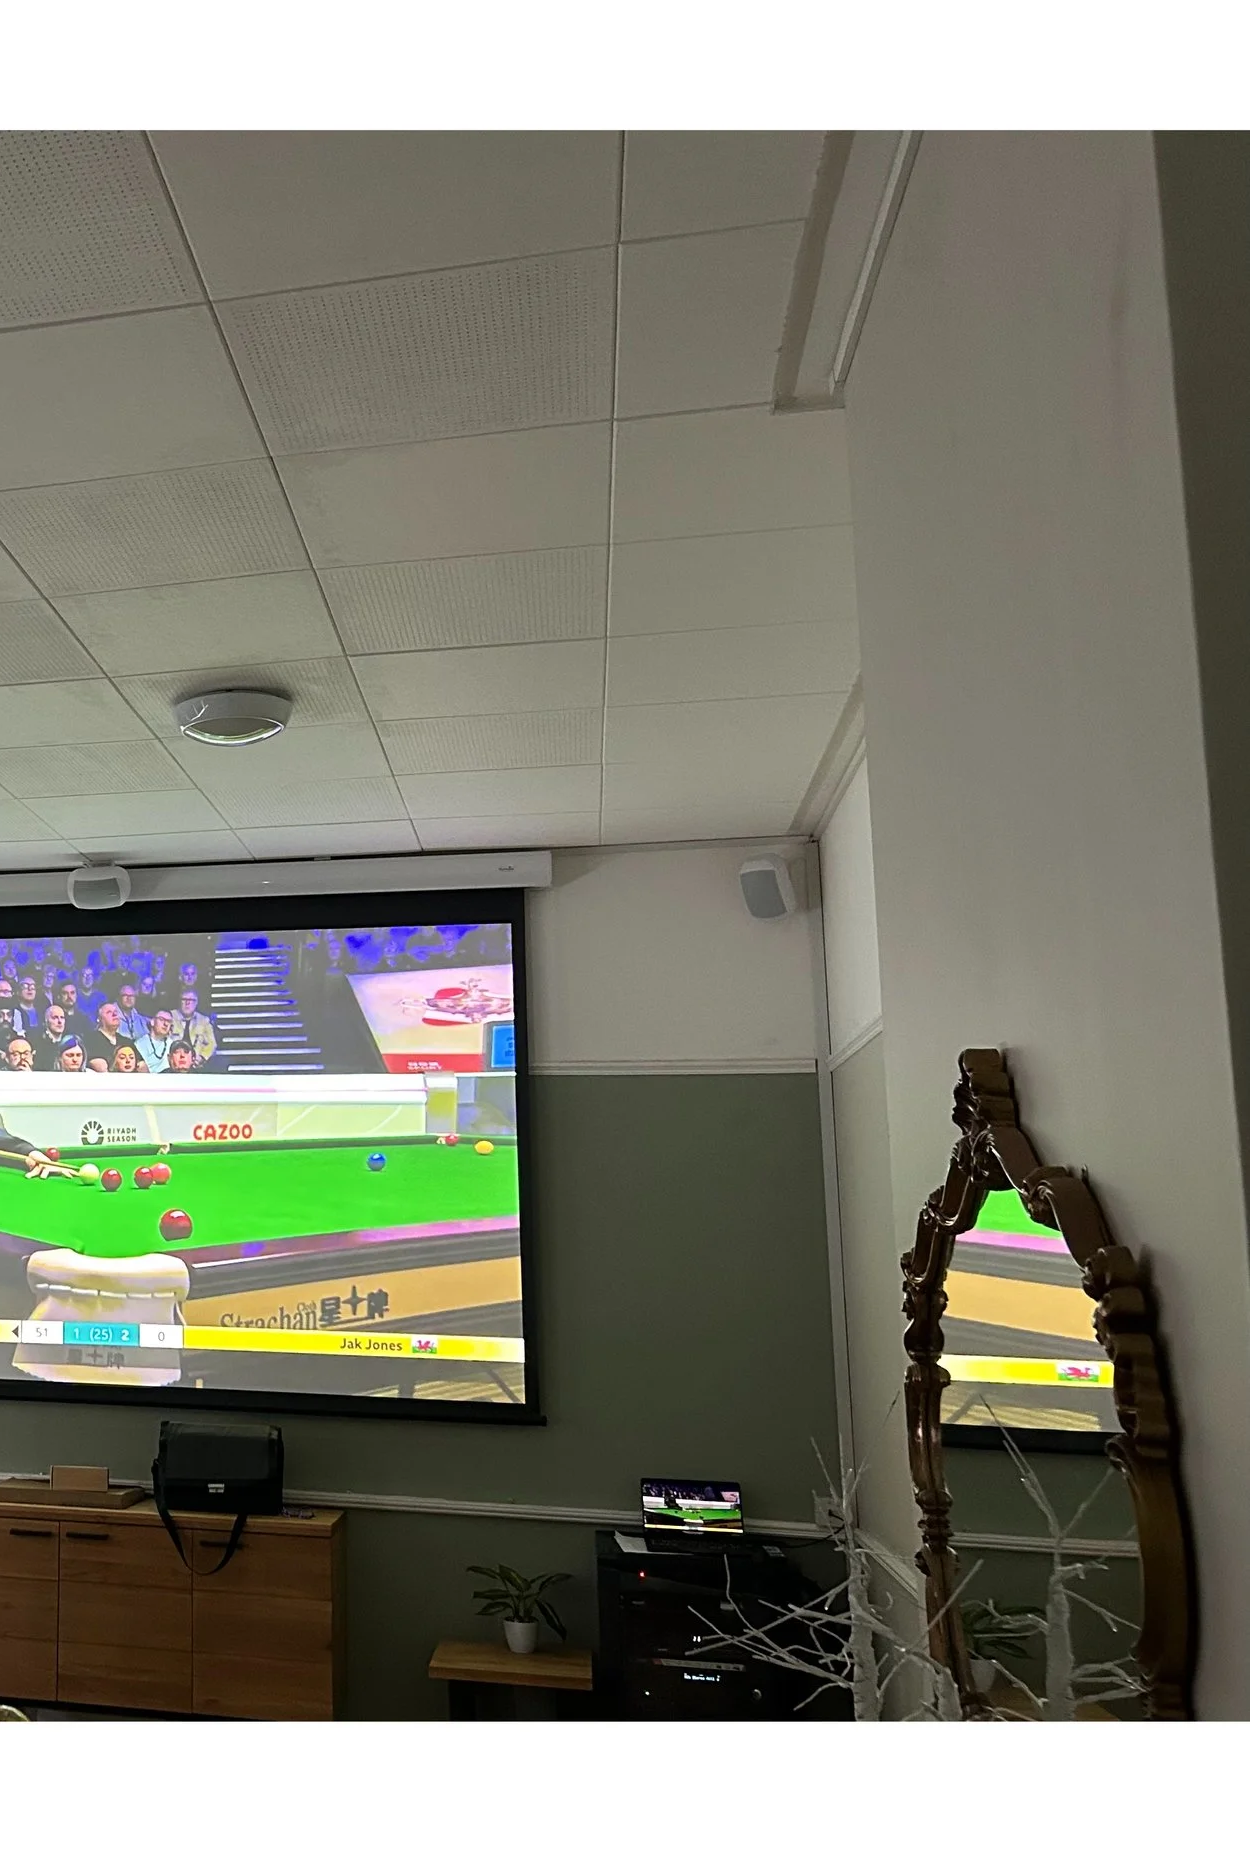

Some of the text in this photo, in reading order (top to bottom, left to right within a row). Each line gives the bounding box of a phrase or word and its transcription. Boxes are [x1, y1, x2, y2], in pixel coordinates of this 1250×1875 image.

[107, 1127, 137, 1135] RIYADH
[193, 1124, 253, 1141] CAZOO
[107, 1135, 137, 1143] SEASON
[36, 1327, 48, 1338] 51
[73, 1327, 130, 1342] 1 (25) 2
[158, 1332, 165, 1341] 0
[340, 1338, 403, 1351] Jak Jones
